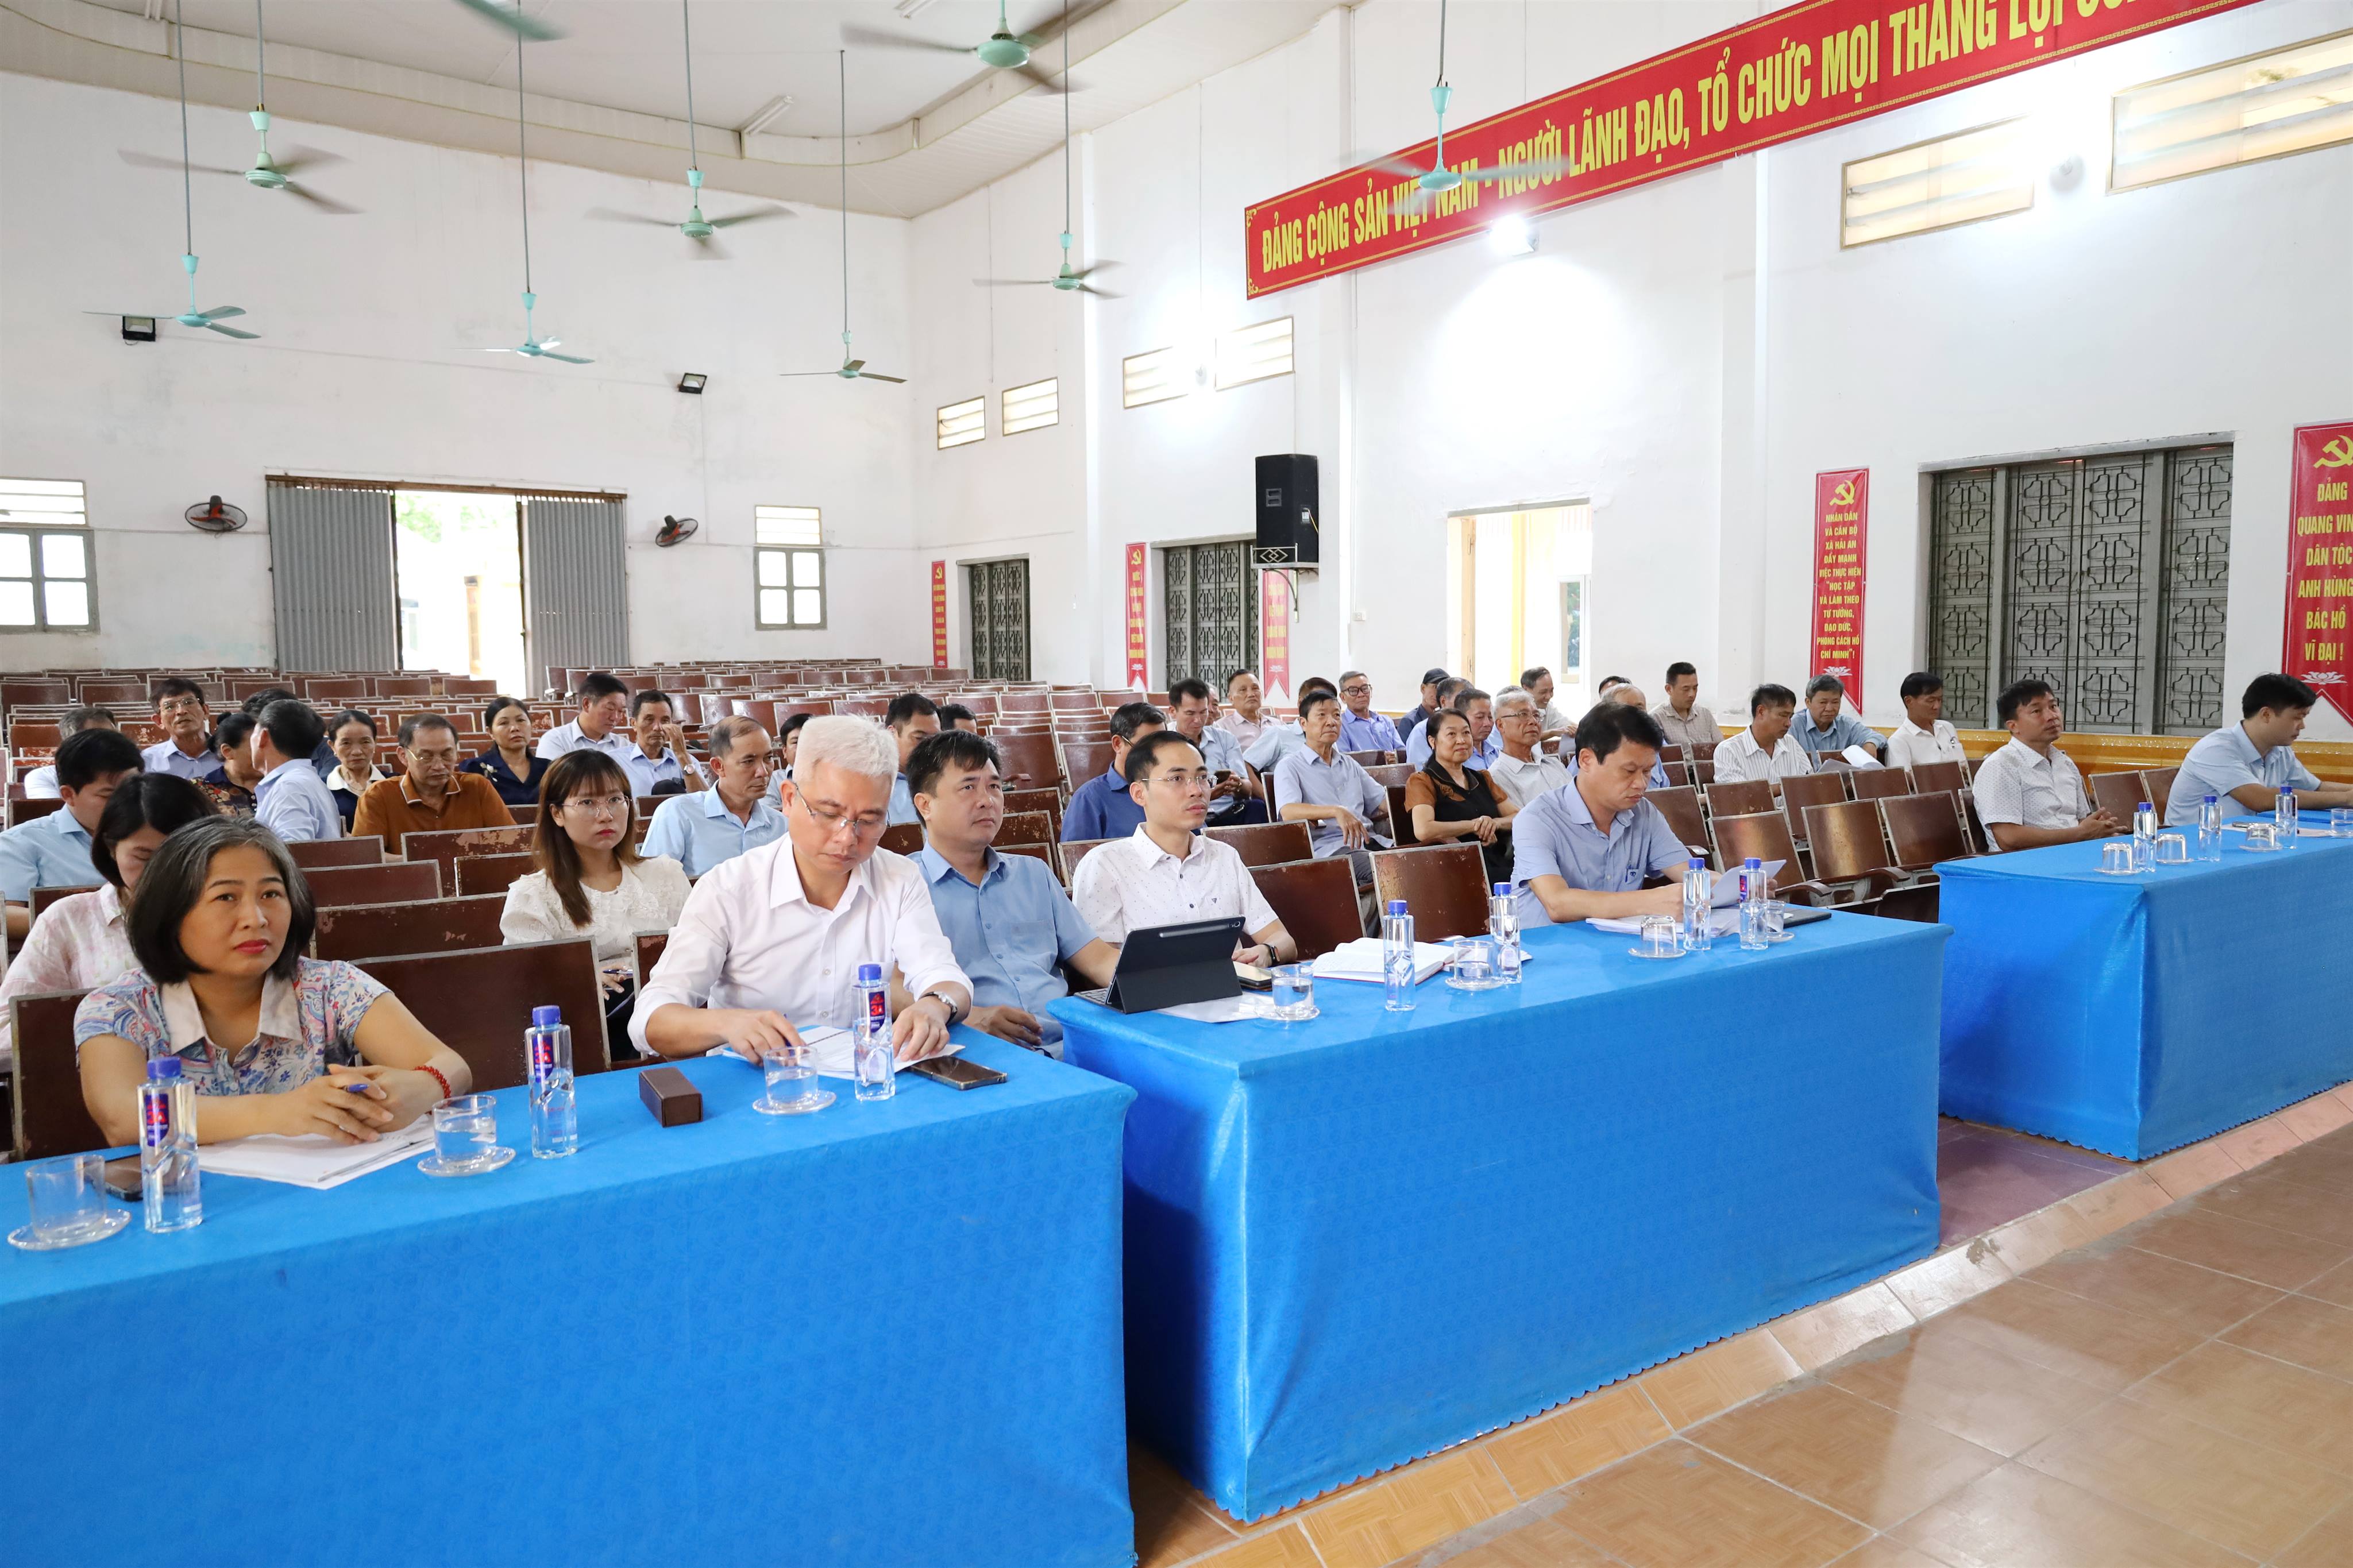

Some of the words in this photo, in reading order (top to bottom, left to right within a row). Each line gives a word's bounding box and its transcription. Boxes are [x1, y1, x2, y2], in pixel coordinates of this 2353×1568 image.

[1263, 211, 1302, 273] ĐẢNG
[1307, 201, 1349, 265] CỘNG
[1354, 177, 1388, 244] SẢN
[1436, 157, 1478, 219] NAM
[1499, 119, 1561, 199] NGƯỜI
[1569, 106, 1627, 177] LÃNH
[1634, 87, 1689, 163] ĐẠO,
[1698, 47, 1731, 136] TỔ
[1738, 37, 1811, 123] CHỨC
[1822, 20, 1878, 103] MỌI
[2317, 477, 2348, 502] ĐẢNG
[1834, 525, 1847, 536] CÁN
[2297, 515, 2333, 536] QUANG
[1847, 540, 1856, 549] AN
[1838, 554, 1857, 565] MẠNH
[2306, 544, 2329, 566] DÂN
[2332, 542, 2353, 569] TỘC
[1819, 567, 1831, 579] VIỆC
[1848, 566, 1861, 578] HIỆN
[1843, 580, 1855, 592] TẬP
[2298, 580, 2321, 598] ANH
[2324, 575, 2353, 597] HÙNG
[1829, 594, 1842, 605] LÀM
[1844, 596, 1859, 604] THEO
[2306, 607, 2328, 629] BÁC
[2331, 604, 2346, 629] HỒ
[1817, 637, 1835, 646] PHONG
[1836, 635, 1850, 645] CÁCH
[1820, 648, 1831, 659] CHÍ
[2305, 639, 2316, 661] VĨ
[2318, 643, 2336, 665] ĐẠI
